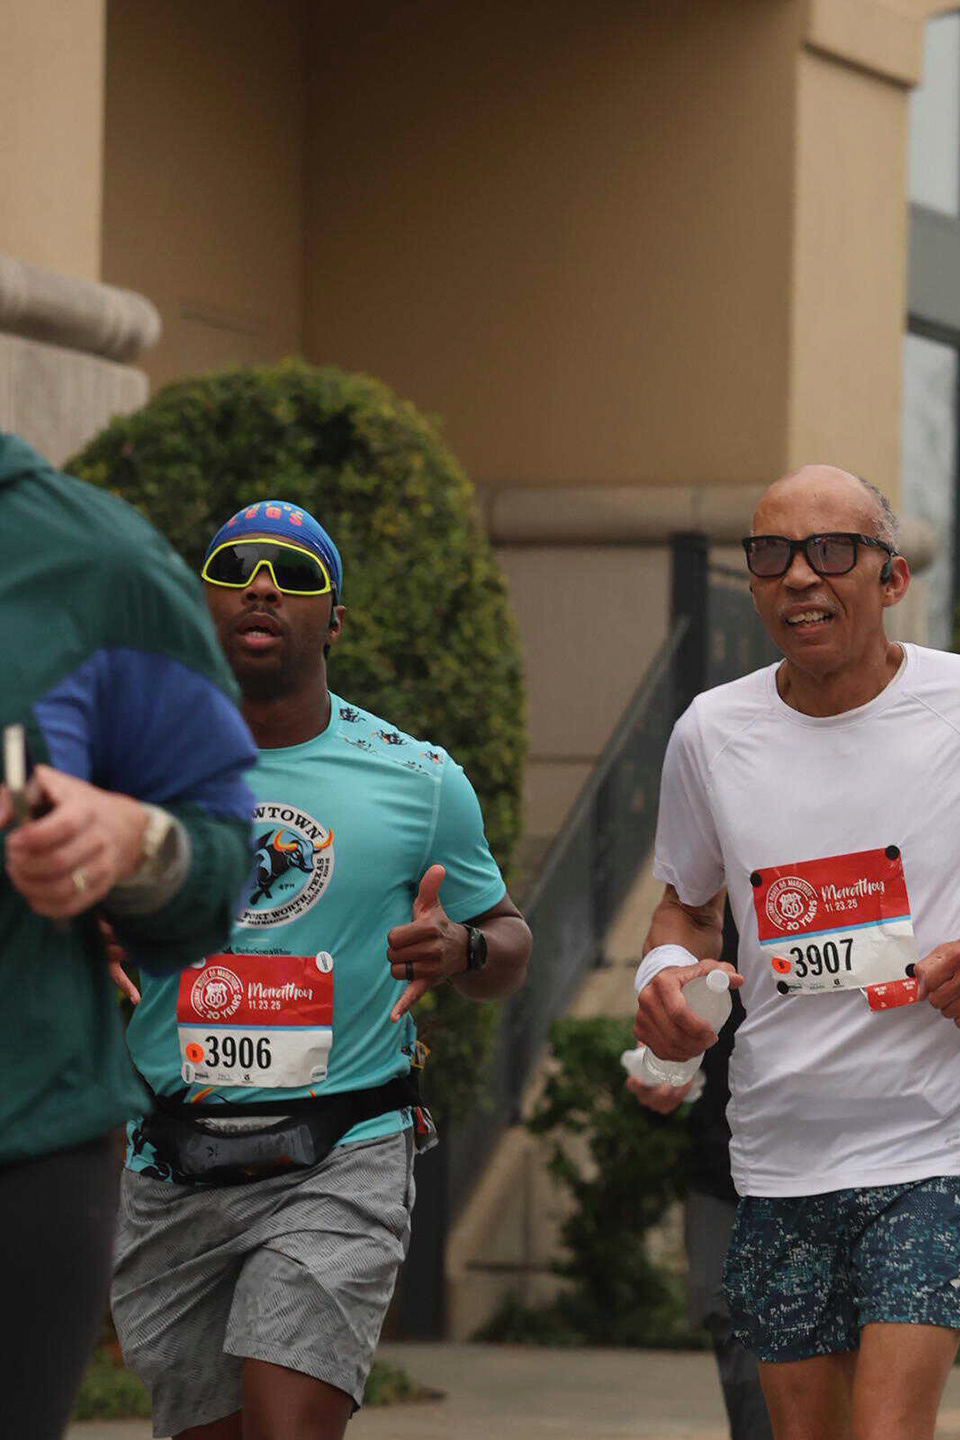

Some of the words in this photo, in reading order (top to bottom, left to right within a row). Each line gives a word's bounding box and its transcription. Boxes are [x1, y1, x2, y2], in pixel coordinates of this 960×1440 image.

[253, 806, 325, 840] WTOWN
[307, 858, 325, 891] TEXAS
[821, 878, 885, 901] Marathon
[786, 921, 800, 931] 20
[800, 900, 818, 927] YEARS
[824, 899, 858, 912] 11.23.25
[790, 938, 854, 978] 3907
[221, 993, 242, 1019] YEARS
[247, 982, 313, 1001] Marathon
[205, 1036, 272, 1069] 3906
